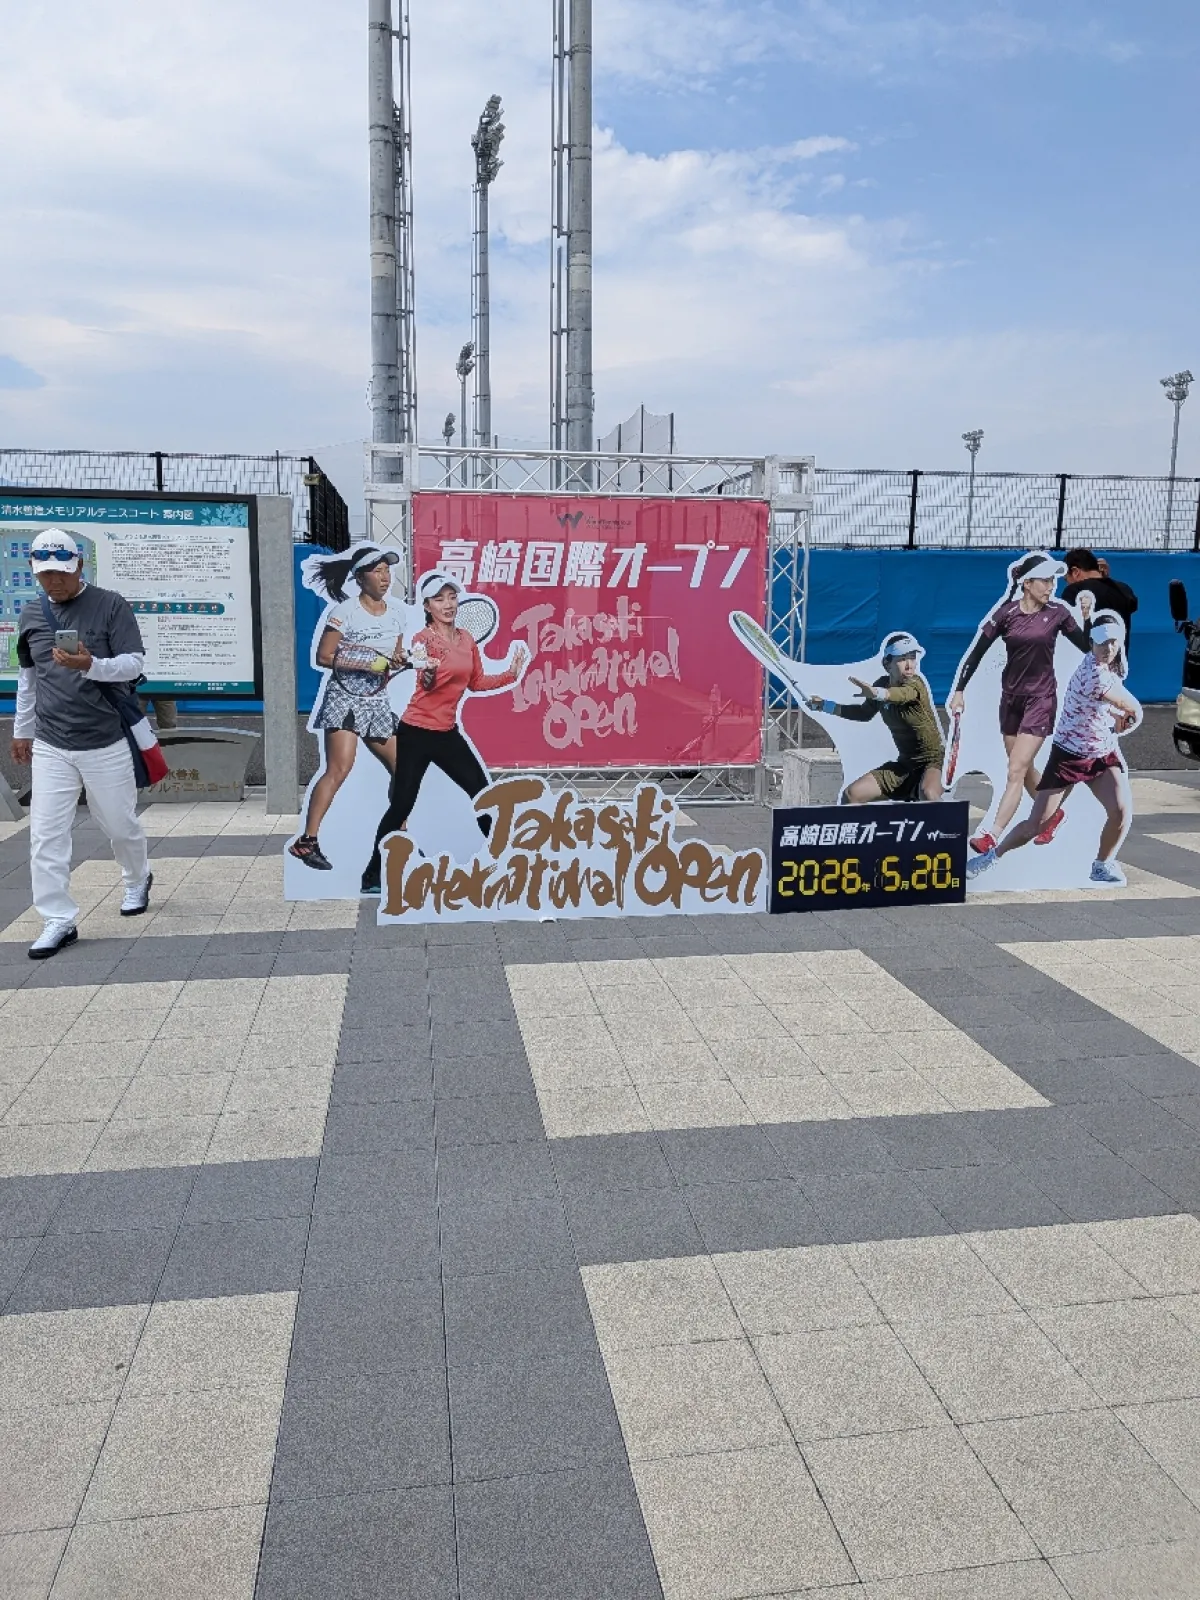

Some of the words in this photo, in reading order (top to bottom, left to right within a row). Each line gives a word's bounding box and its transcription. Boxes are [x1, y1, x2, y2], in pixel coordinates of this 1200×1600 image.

[435, 539, 750, 588] 高崎国際オープン
[511, 596, 643, 660] Takasaki
[511, 626, 681, 713] International
[140, 780, 239, 794] アルテニスコート
[165, 768, 200, 781] 水善造
[475, 778, 673, 859] Takasaki
[780, 818, 925, 847] 高崎国際オープン
[381, 835, 633, 915] International
[635, 840, 763, 909] Open
